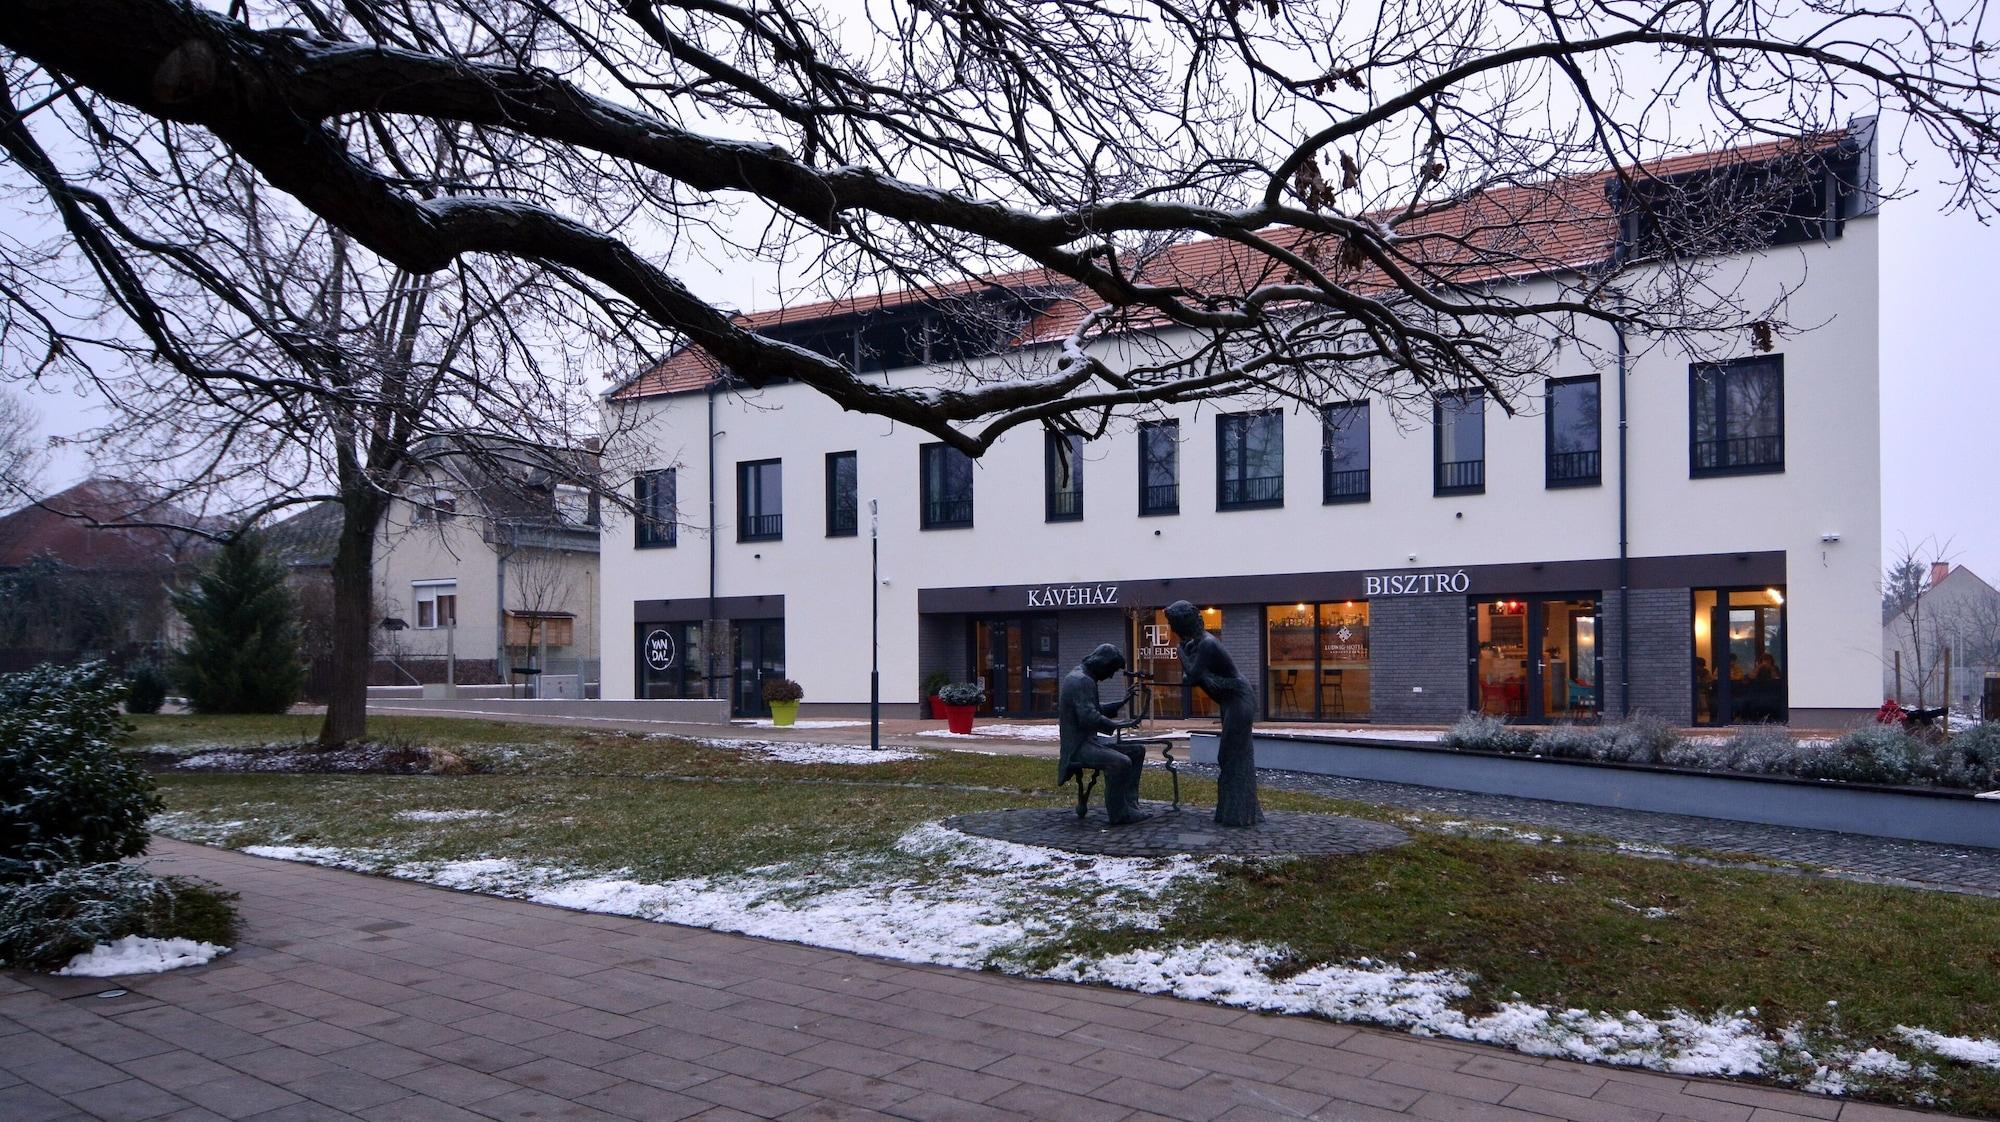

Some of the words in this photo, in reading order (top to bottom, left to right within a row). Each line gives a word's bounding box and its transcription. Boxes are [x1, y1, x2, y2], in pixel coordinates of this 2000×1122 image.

[1365, 569, 1470, 595] BISZTRÓ
[1027, 584, 1118, 607] KÁVÉHÁZ
[1154, 647, 1178, 660] ELISE
